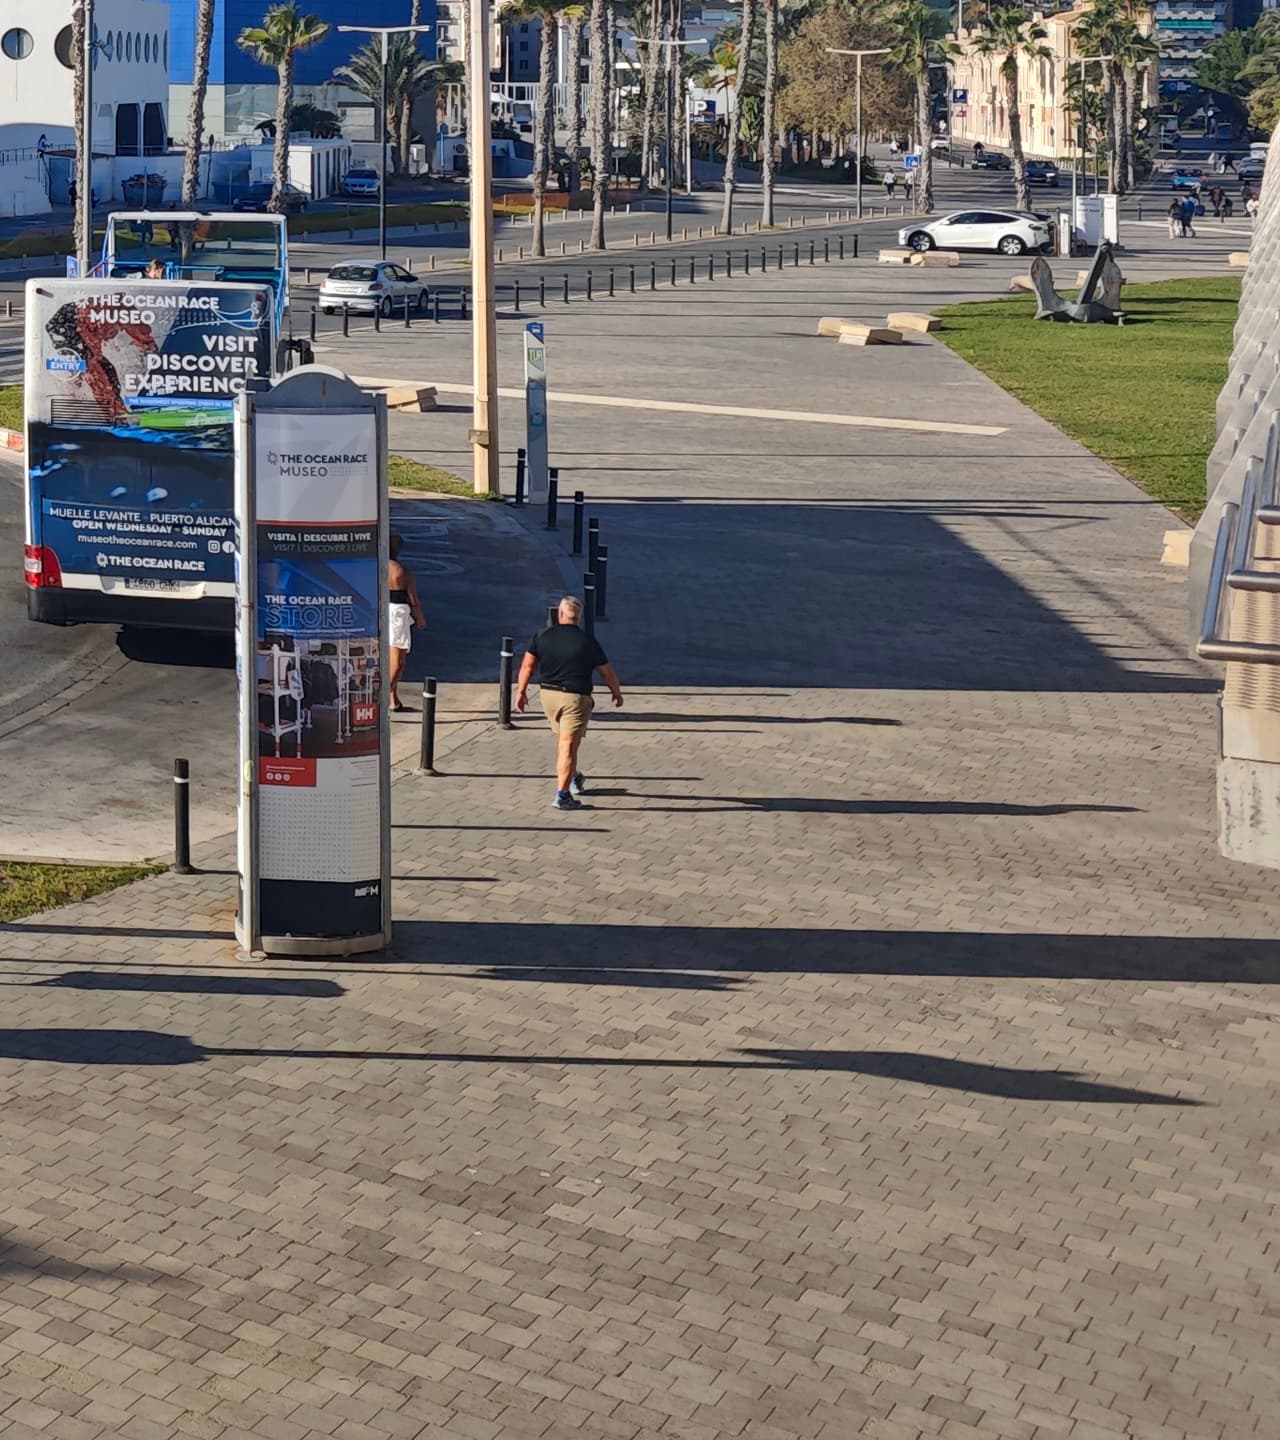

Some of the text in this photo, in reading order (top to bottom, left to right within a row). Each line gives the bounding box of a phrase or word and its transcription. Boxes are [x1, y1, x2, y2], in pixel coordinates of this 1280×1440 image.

[92, 294, 220, 309] THE OCEAN RACE
[90, 309, 156, 325] MUSEO
[202, 334, 258, 353] VISIT
[50, 362, 81, 371] ENTRY
[146, 354, 259, 373] DISCOVER
[124, 373, 246, 394] EXPERIENC
[280, 454, 368, 464] THE OCEAN RACE
[280, 466, 328, 477] MUSEO
[49, 508, 91, 519] MUELLE
[93, 510, 141, 521] LEVANTE
[150, 513, 194, 524] PUERTO
[196, 516, 236, 527] ALICAN
[72, 520, 103, 530] OPEN
[105, 521, 172, 534] WEDNESDAY
[182, 526, 227, 537] SUNDAY
[78, 534, 198, 549] museotheoceanrace.com
[267, 532, 297, 541] VISITA
[303, 533, 348, 542] DESCUBRE
[109, 555, 205, 571] THE OCEAN RACE
[265, 595, 353, 605] THE OCEAN RACE
[266, 605, 353, 627] STORE
